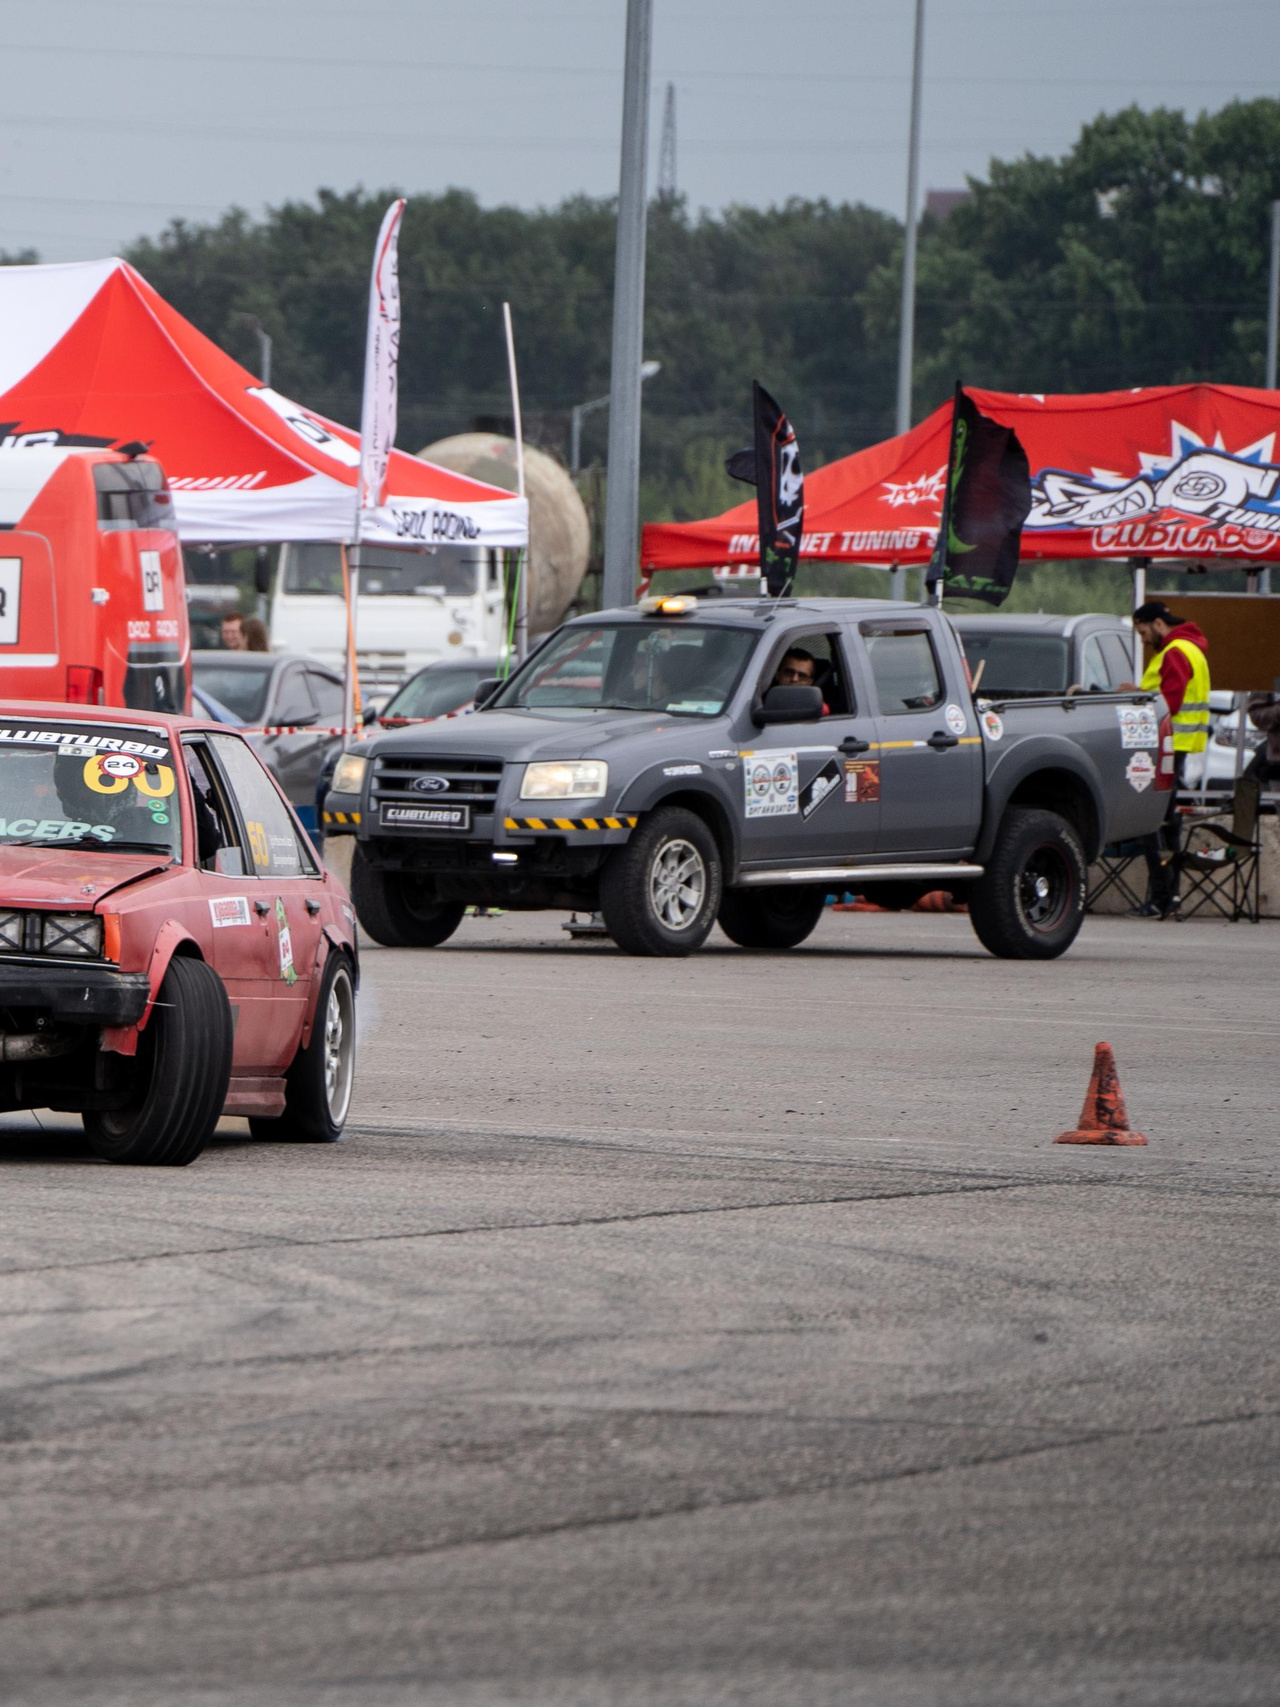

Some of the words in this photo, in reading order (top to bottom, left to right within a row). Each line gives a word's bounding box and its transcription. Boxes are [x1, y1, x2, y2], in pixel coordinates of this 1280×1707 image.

[1209, 503, 1280, 533] TUNI
[728, 532, 835, 554] INTNET
[838, 529, 920, 552] TUNING
[83, 754, 176, 798] 60
[107, 760, 137, 770] 24
[420, 779, 441, 790] Ford
[386, 808, 462, 823] CLUBTURBO
[246, 820, 269, 867] 60
